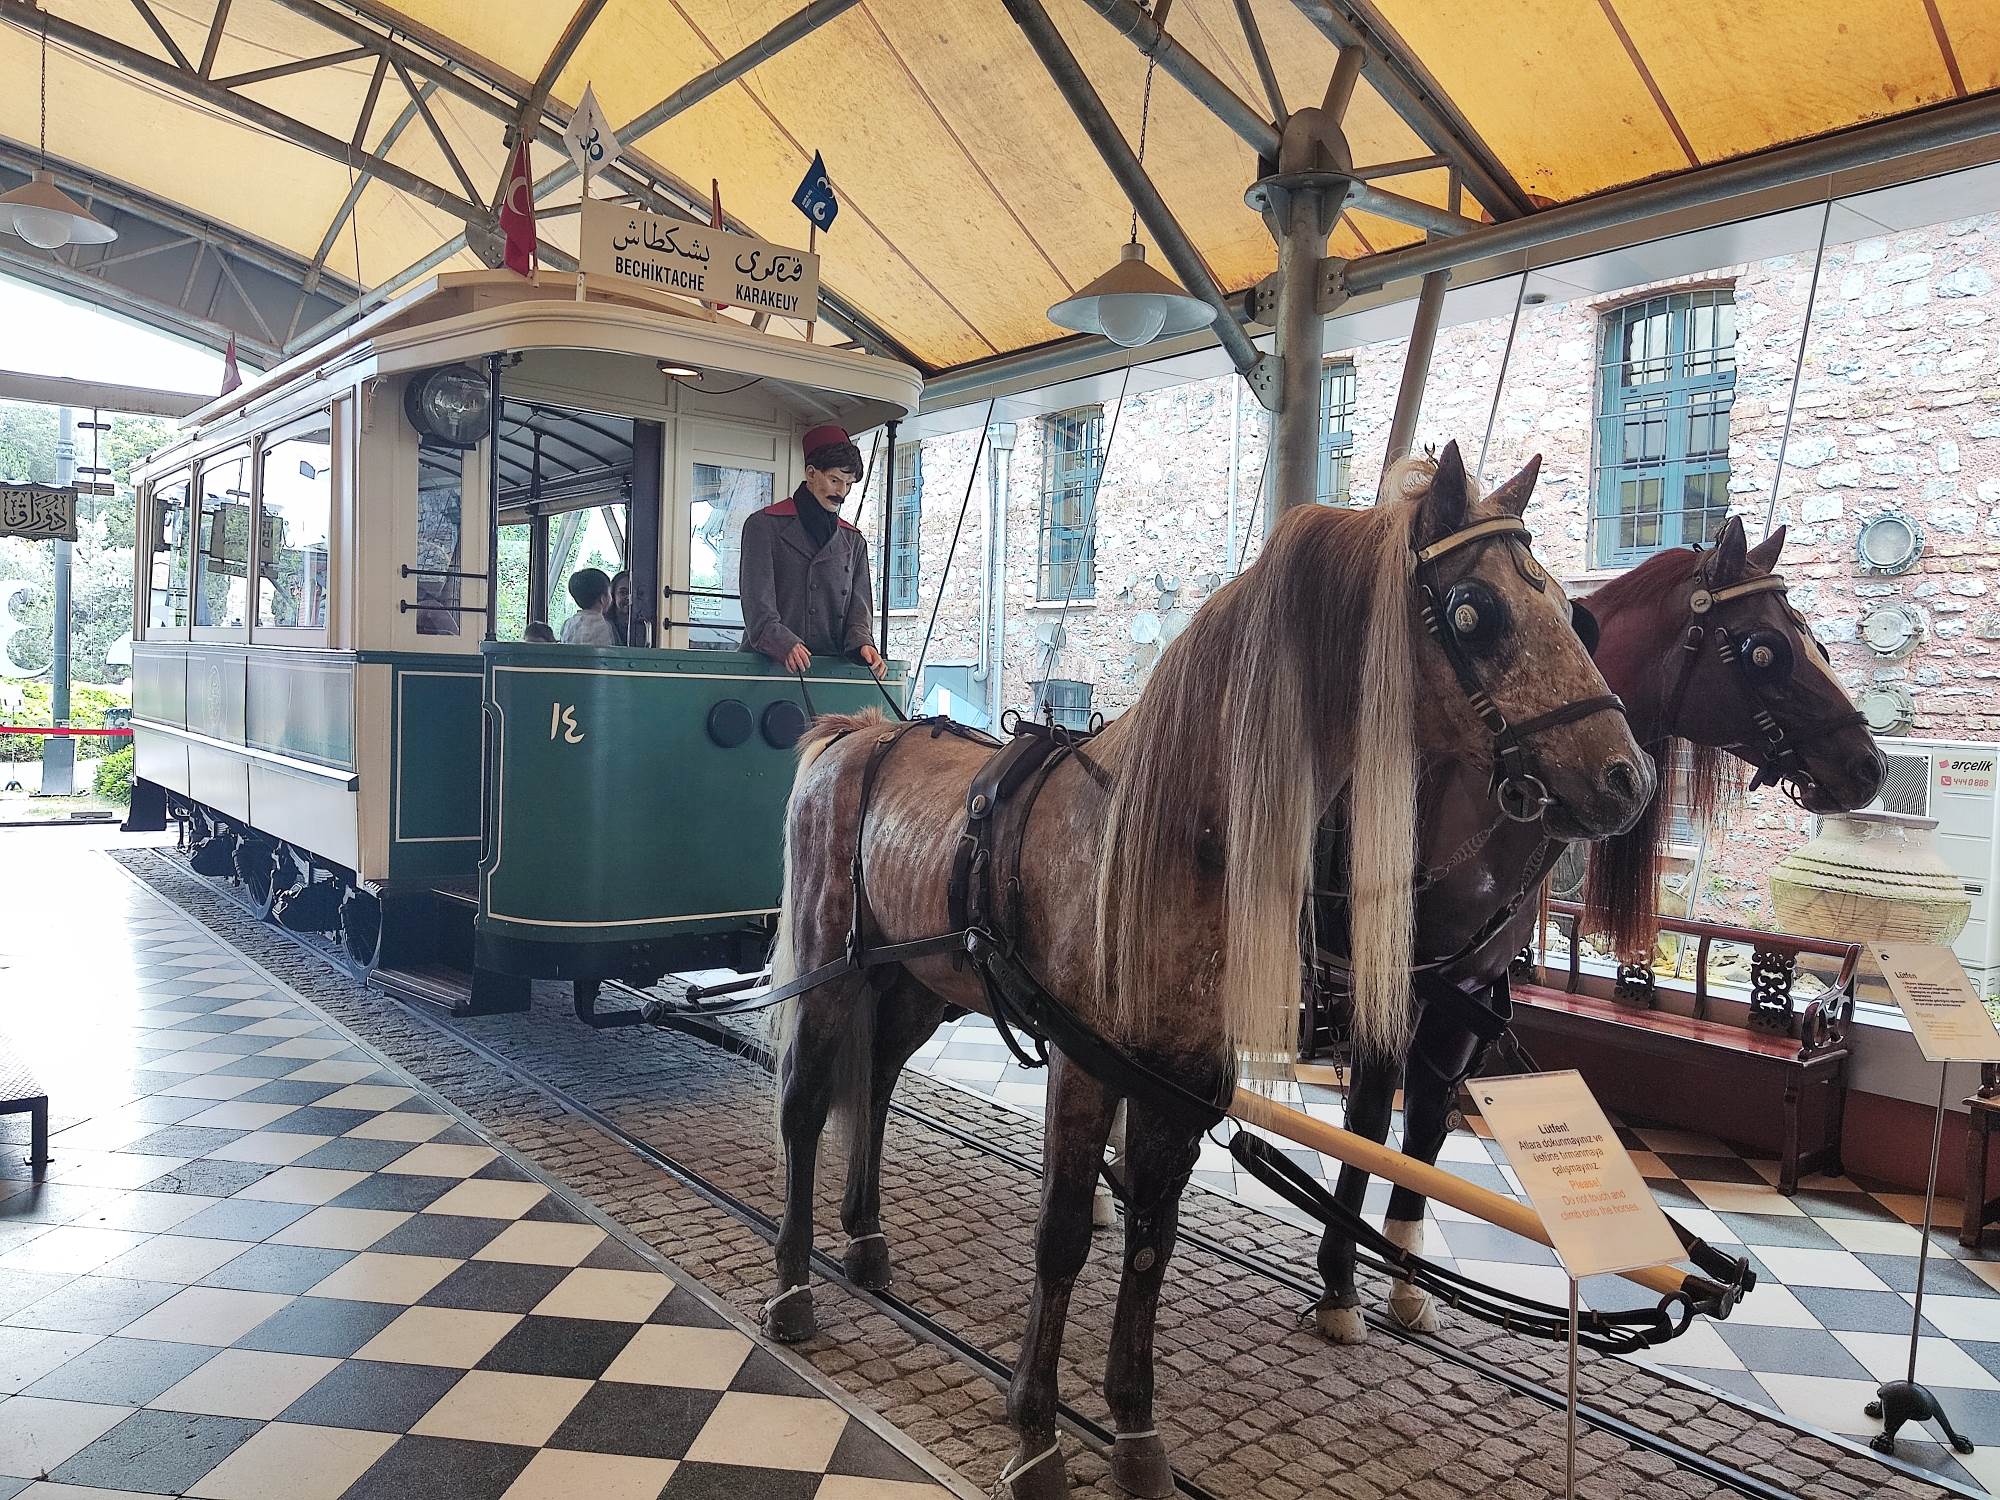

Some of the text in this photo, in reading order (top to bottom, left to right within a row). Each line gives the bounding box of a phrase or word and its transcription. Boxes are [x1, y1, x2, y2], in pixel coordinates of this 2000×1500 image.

[736, 283, 799, 312] KARAKEUY
[1951, 760, 1993, 773] arçelik
[1538, 1122, 1570, 1135] Lütfen!
[1519, 1134, 1604, 1151] Atlara dokunmayınız ve
[1533, 1148, 1604, 1163] üstüne tırmanmaya
[1561, 1195, 1575, 1206] Do
[1587, 1191, 1611, 1203] touch
[1609, 1189, 1626, 1201] and
